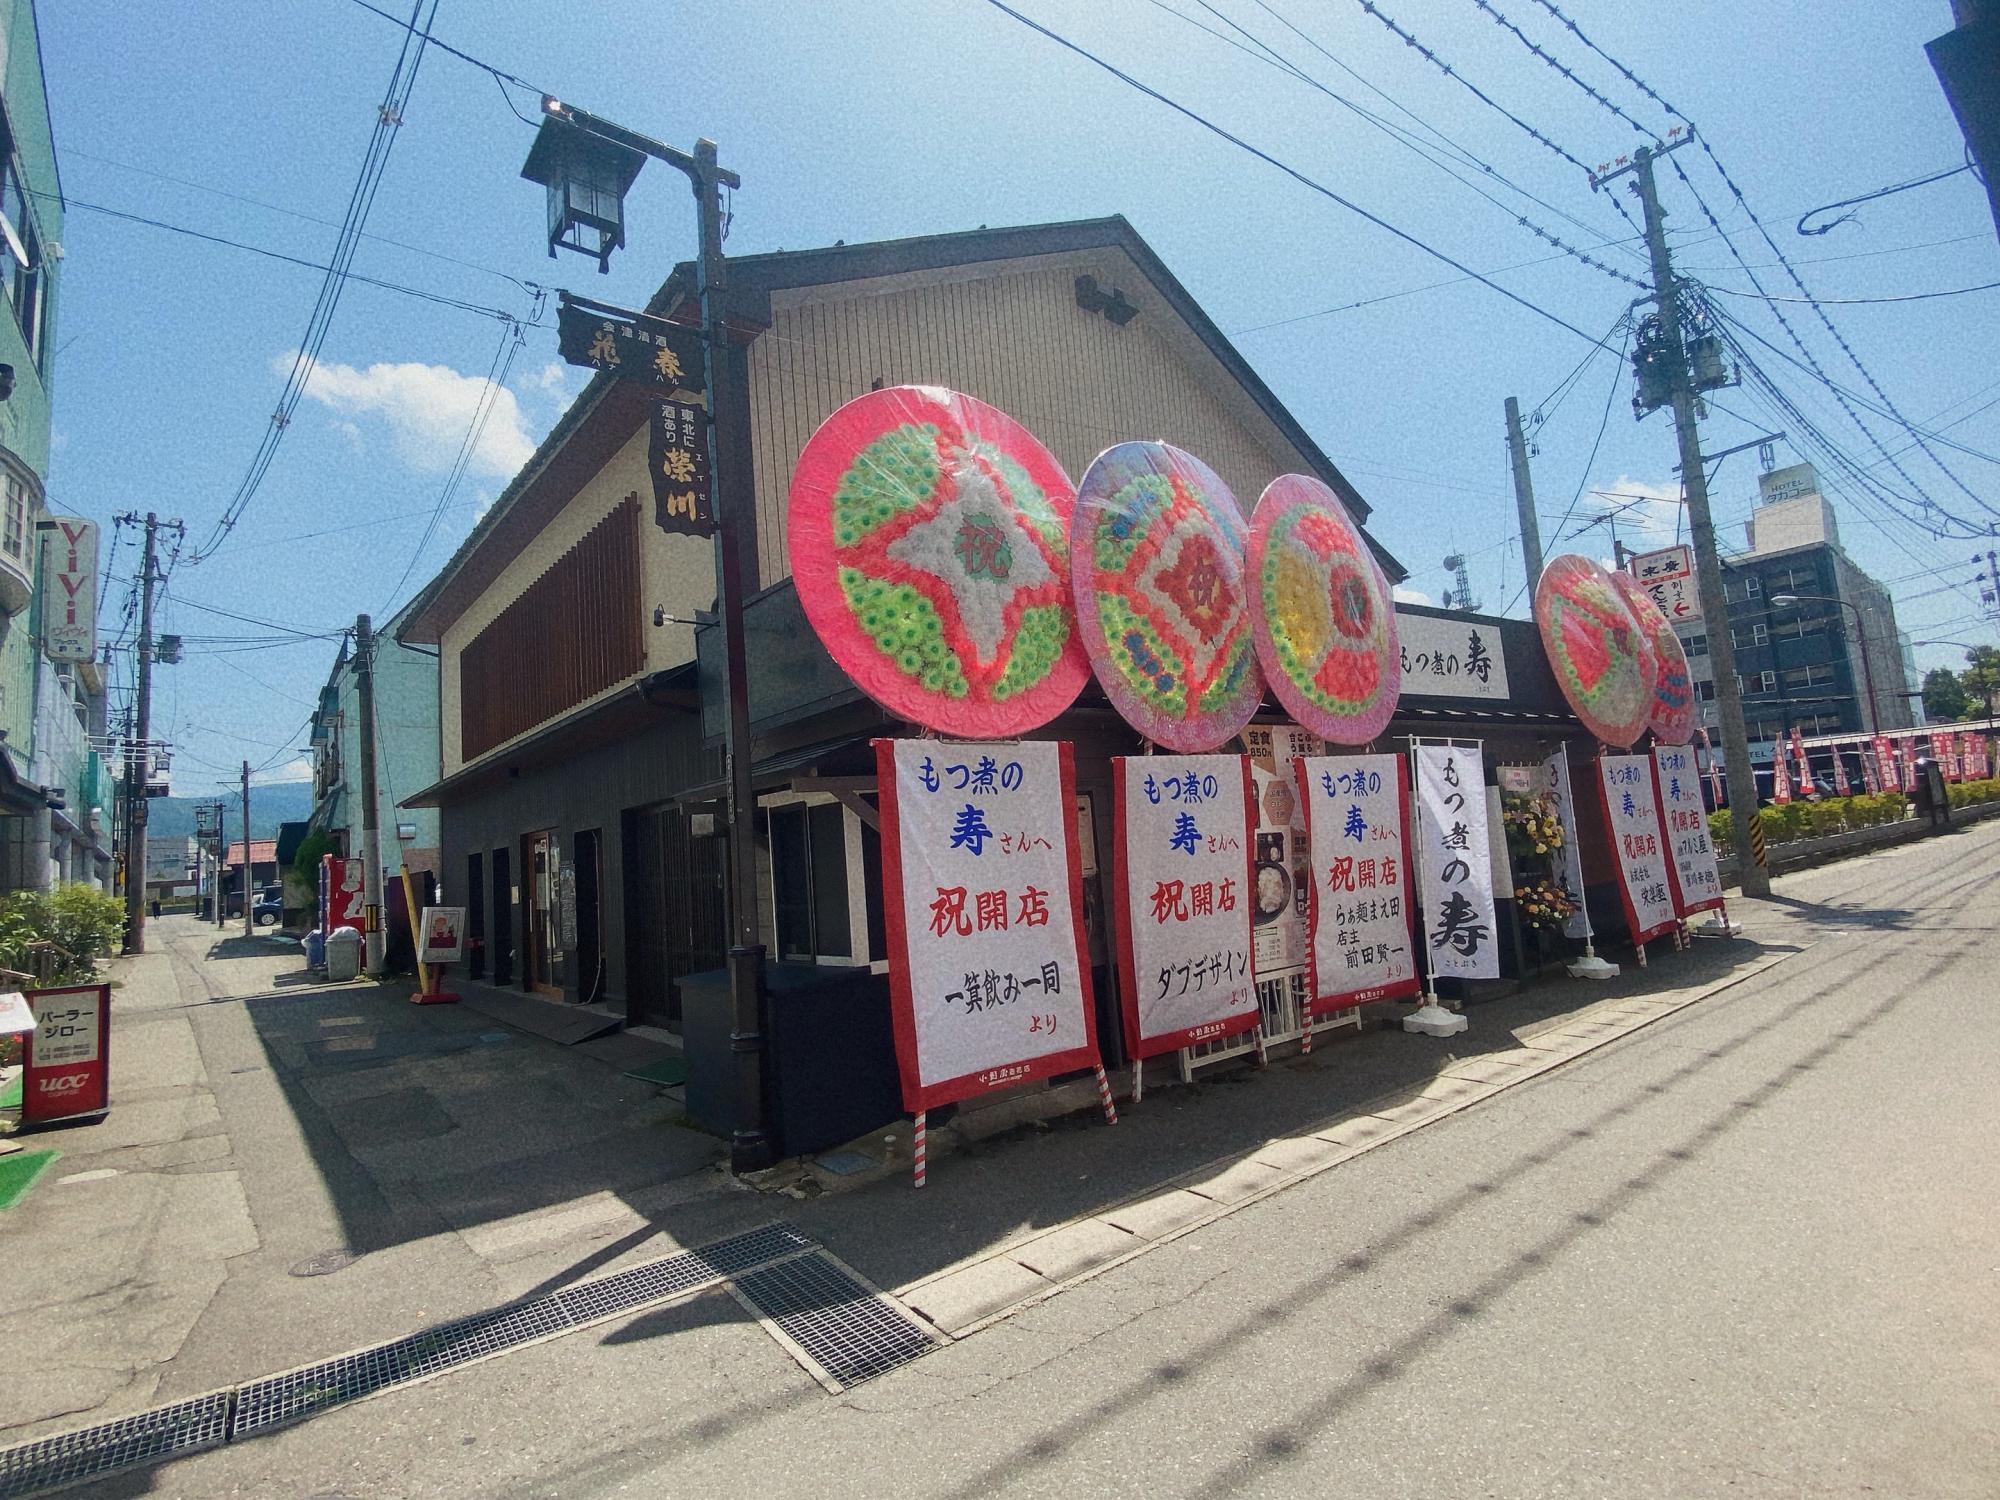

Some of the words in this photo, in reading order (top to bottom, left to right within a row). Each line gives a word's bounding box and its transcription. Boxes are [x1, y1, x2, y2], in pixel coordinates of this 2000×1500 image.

[662, 405, 676, 443] 酒あり
[681, 409, 695, 448] 東北に
[1772, 479, 1804, 492] HOTEL
[1400, 628, 1492, 684] もつ煮の寿
[1248, 730, 1271, 746] 定食
[1250, 747, 1272, 758] 850円
[1659, 751, 1687, 772] もつ煮の
[918, 756, 1023, 796] もつ煮の
[1143, 769, 1219, 805] もつ煮の
[1321, 767, 1381, 798] もつ煮の
[1608, 763, 1641, 786] もつ煮の
[1430, 757, 1489, 957] もつ煮の寿
[1328, 855, 1398, 893] 祝開店
[929, 885, 1050, 938] 祝開店
[1150, 877, 1236, 925] 祝開店
[1336, 929, 1360, 946] 店主
[1345, 943, 1404, 969] 前田賢一
[1157, 949, 1248, 1001] ダブデザイン
[1386, 964, 1403, 979] より
[945, 960, 1061, 1015] 一箕飲み一同
[1230, 987, 1248, 1006] より
[39, 1009, 94, 1024] パーラー
[1029, 1014, 1057, 1036] より
[45, 1025, 88, 1039] ジロー
